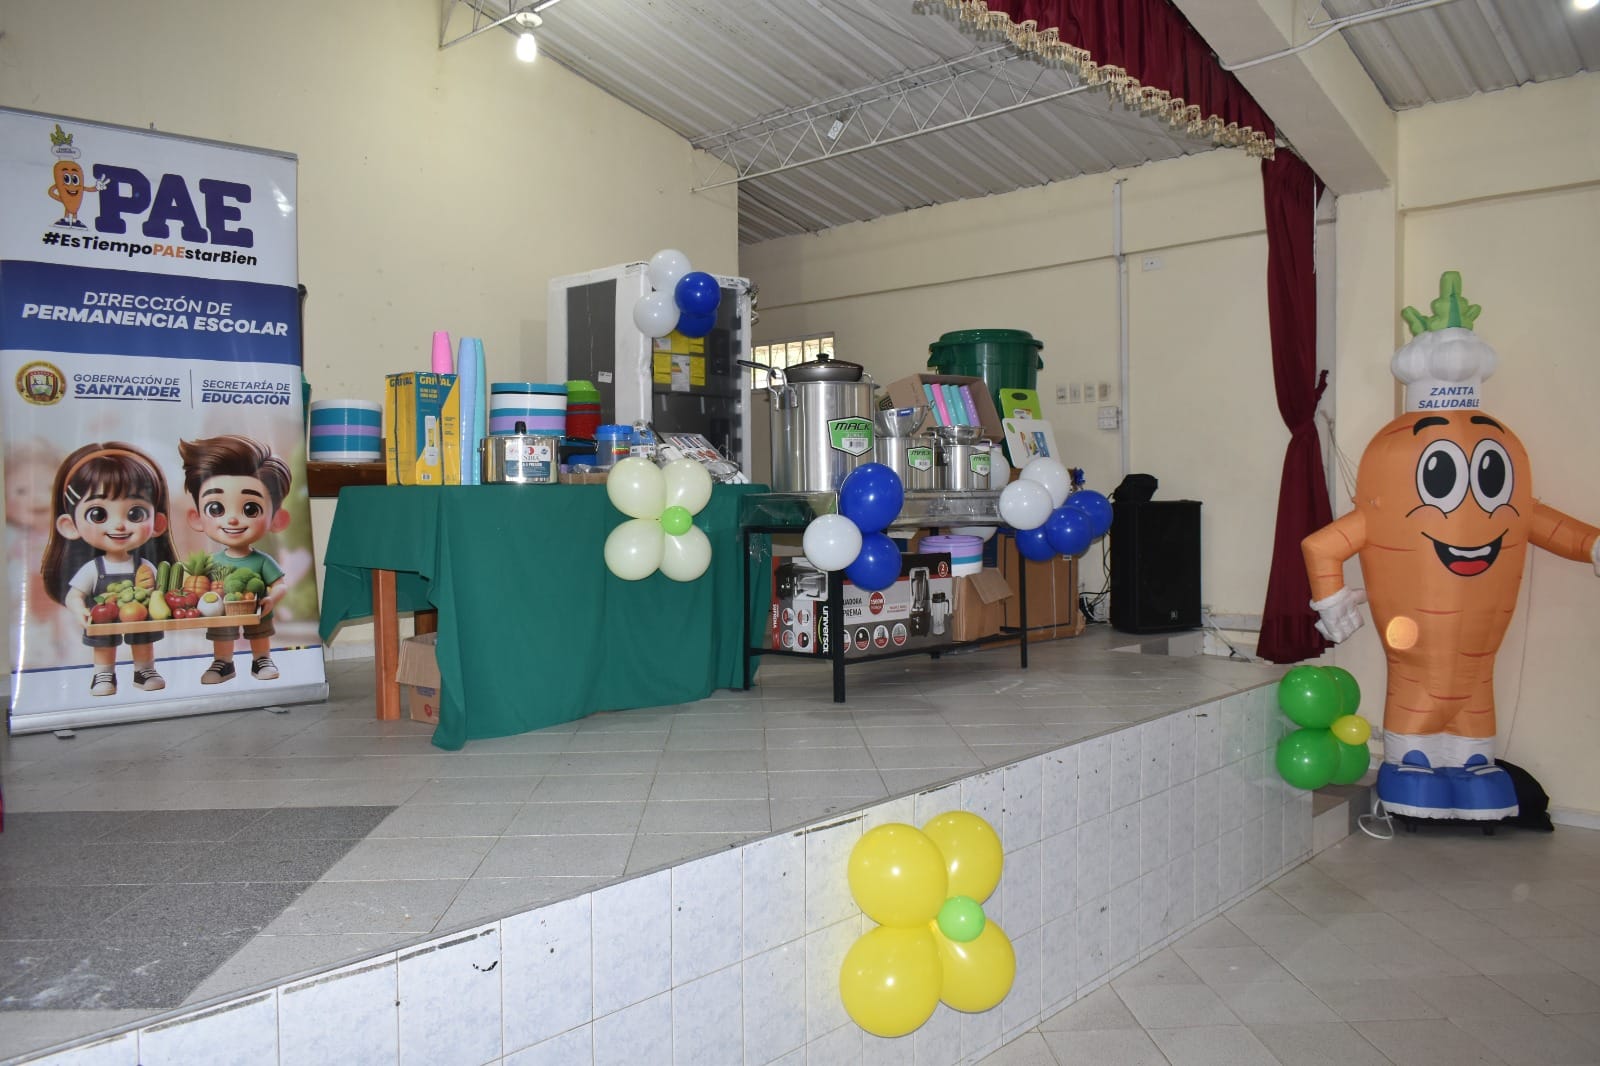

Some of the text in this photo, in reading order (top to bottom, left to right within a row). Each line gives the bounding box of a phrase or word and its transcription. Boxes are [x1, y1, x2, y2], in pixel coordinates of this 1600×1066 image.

[93, 163, 254, 249] PAE
[42, 231, 258, 266] #EsTiempoPAEstarBien
[83, 291, 233, 316] DIRECCIÓN DE
[22, 303, 289, 337] PERMANENCIA ESCOLAR
[73, 373, 180, 386] GOBERNACIÓN DE
[202, 379, 291, 391] SECRETARÍA DE
[420, 376, 451, 387] GRIAL
[74, 383, 181, 398] SANTANDER
[1430, 386, 1474, 396] ZANITA
[202, 391, 291, 406] EDUCACIÓN
[1418, 398, 1480, 409] SALUDABLE
[834, 422, 871, 431] MACK
[844, 608, 862, 617] PREMA
